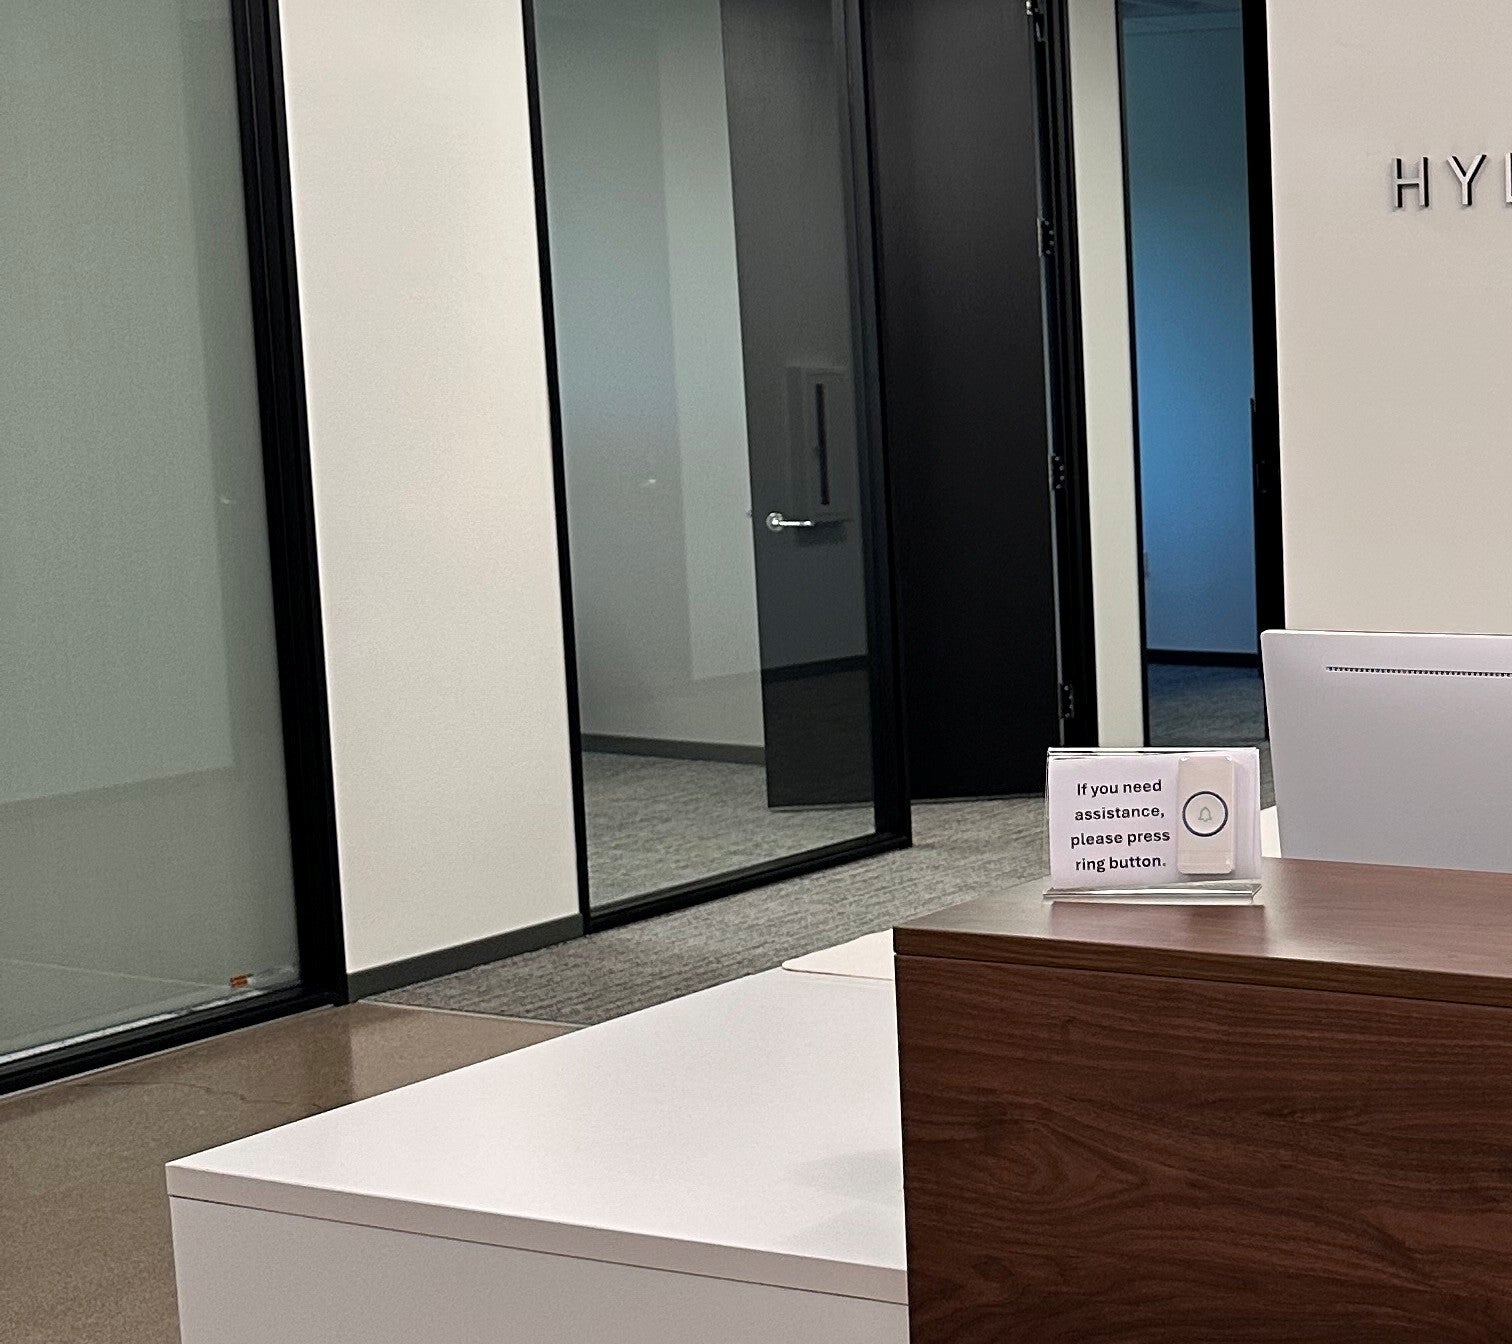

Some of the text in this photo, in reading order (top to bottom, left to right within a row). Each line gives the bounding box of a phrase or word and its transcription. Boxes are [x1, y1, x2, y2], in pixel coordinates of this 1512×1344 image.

[1077, 779, 1162, 798] If you need
[1075, 807, 1165, 821] assistance,
[1070, 831, 1171, 849] please press
[1075, 856, 1167, 872] ring button.
